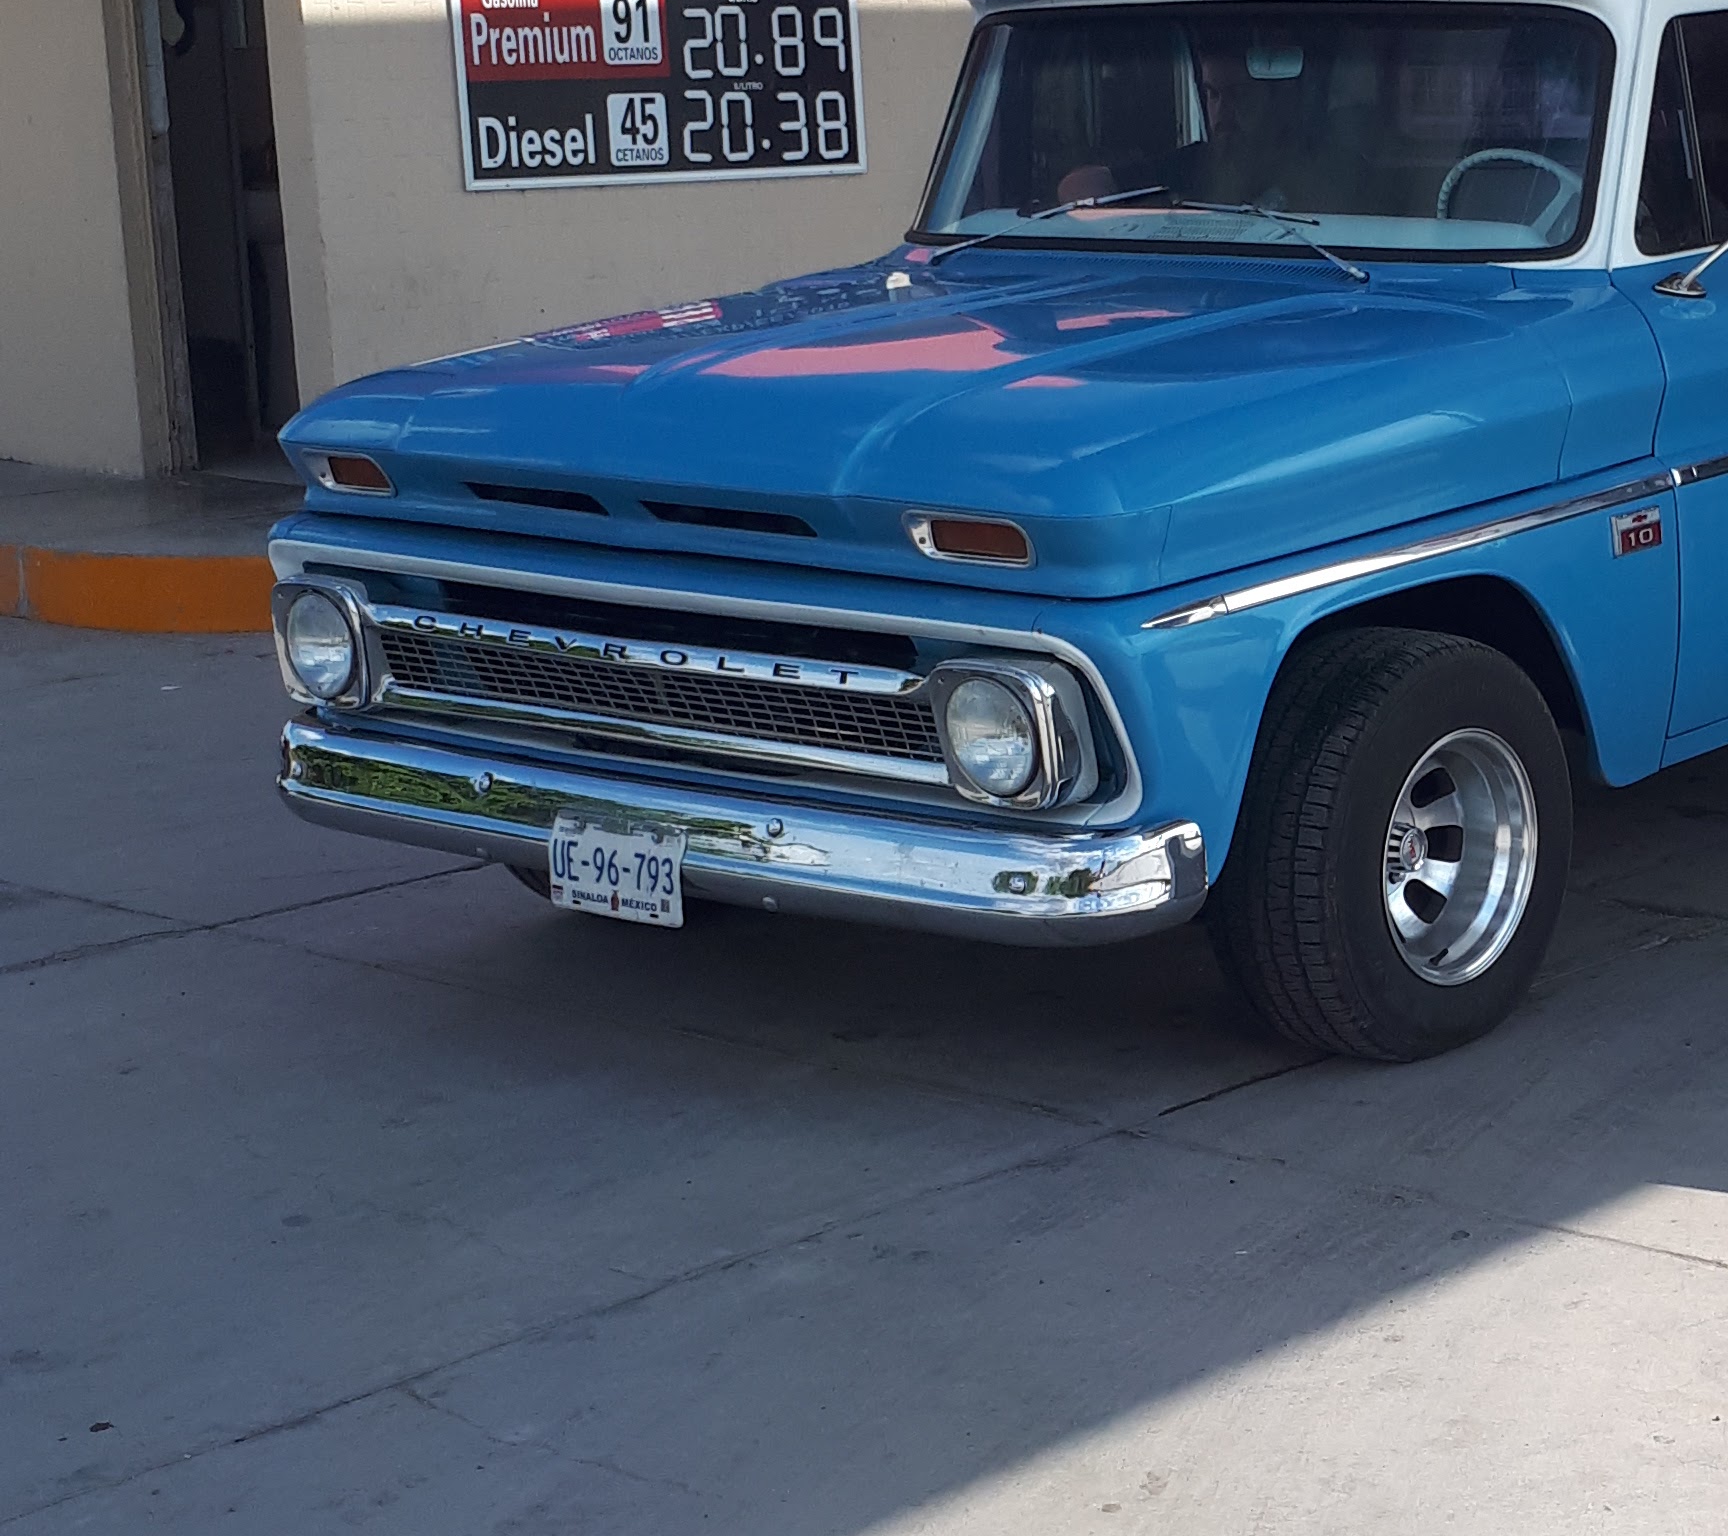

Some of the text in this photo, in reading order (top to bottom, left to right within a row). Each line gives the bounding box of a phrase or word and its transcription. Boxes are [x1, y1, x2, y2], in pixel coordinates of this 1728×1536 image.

[470, 12, 597, 65] Premium
[608, 47, 658, 61] OCTANOS
[683, 5, 847, 80] 20.89
[478, 113, 596, 169] Diesel
[620, 97, 659, 146] 45
[683, 90, 849, 163] 20.38
[615, 147, 664, 162] CETANOS
[1628, 527, 1654, 547] 10
[413, 615, 860, 685] CHEVROLET
[552, 838, 675, 895] UE-96-793
[571, 889, 609, 904] SINALOA
